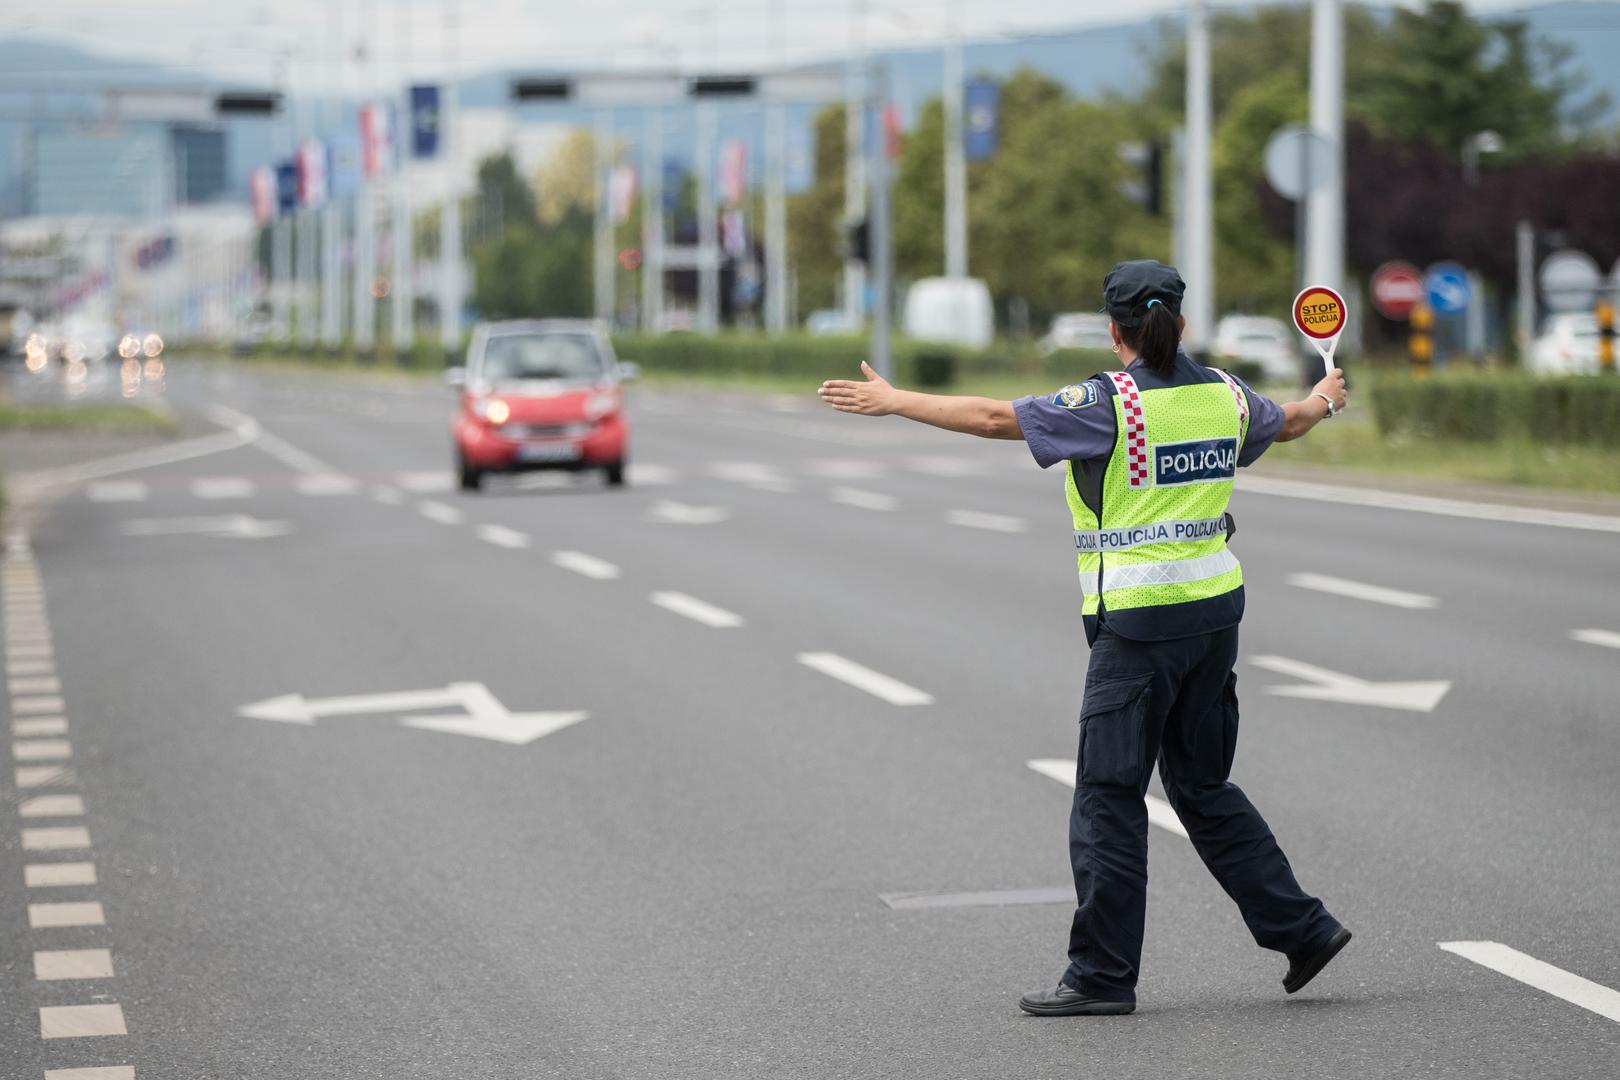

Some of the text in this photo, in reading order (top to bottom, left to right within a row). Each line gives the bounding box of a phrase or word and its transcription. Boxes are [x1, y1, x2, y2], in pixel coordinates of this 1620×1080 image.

[1302, 302, 1336, 314] STOP
[1303, 314, 1338, 324] POLICIJA
[1160, 448, 1234, 475] POLICIJA
[1100, 525, 1169, 548] POLICIJA
[1175, 521, 1217, 538] POLCIJA
